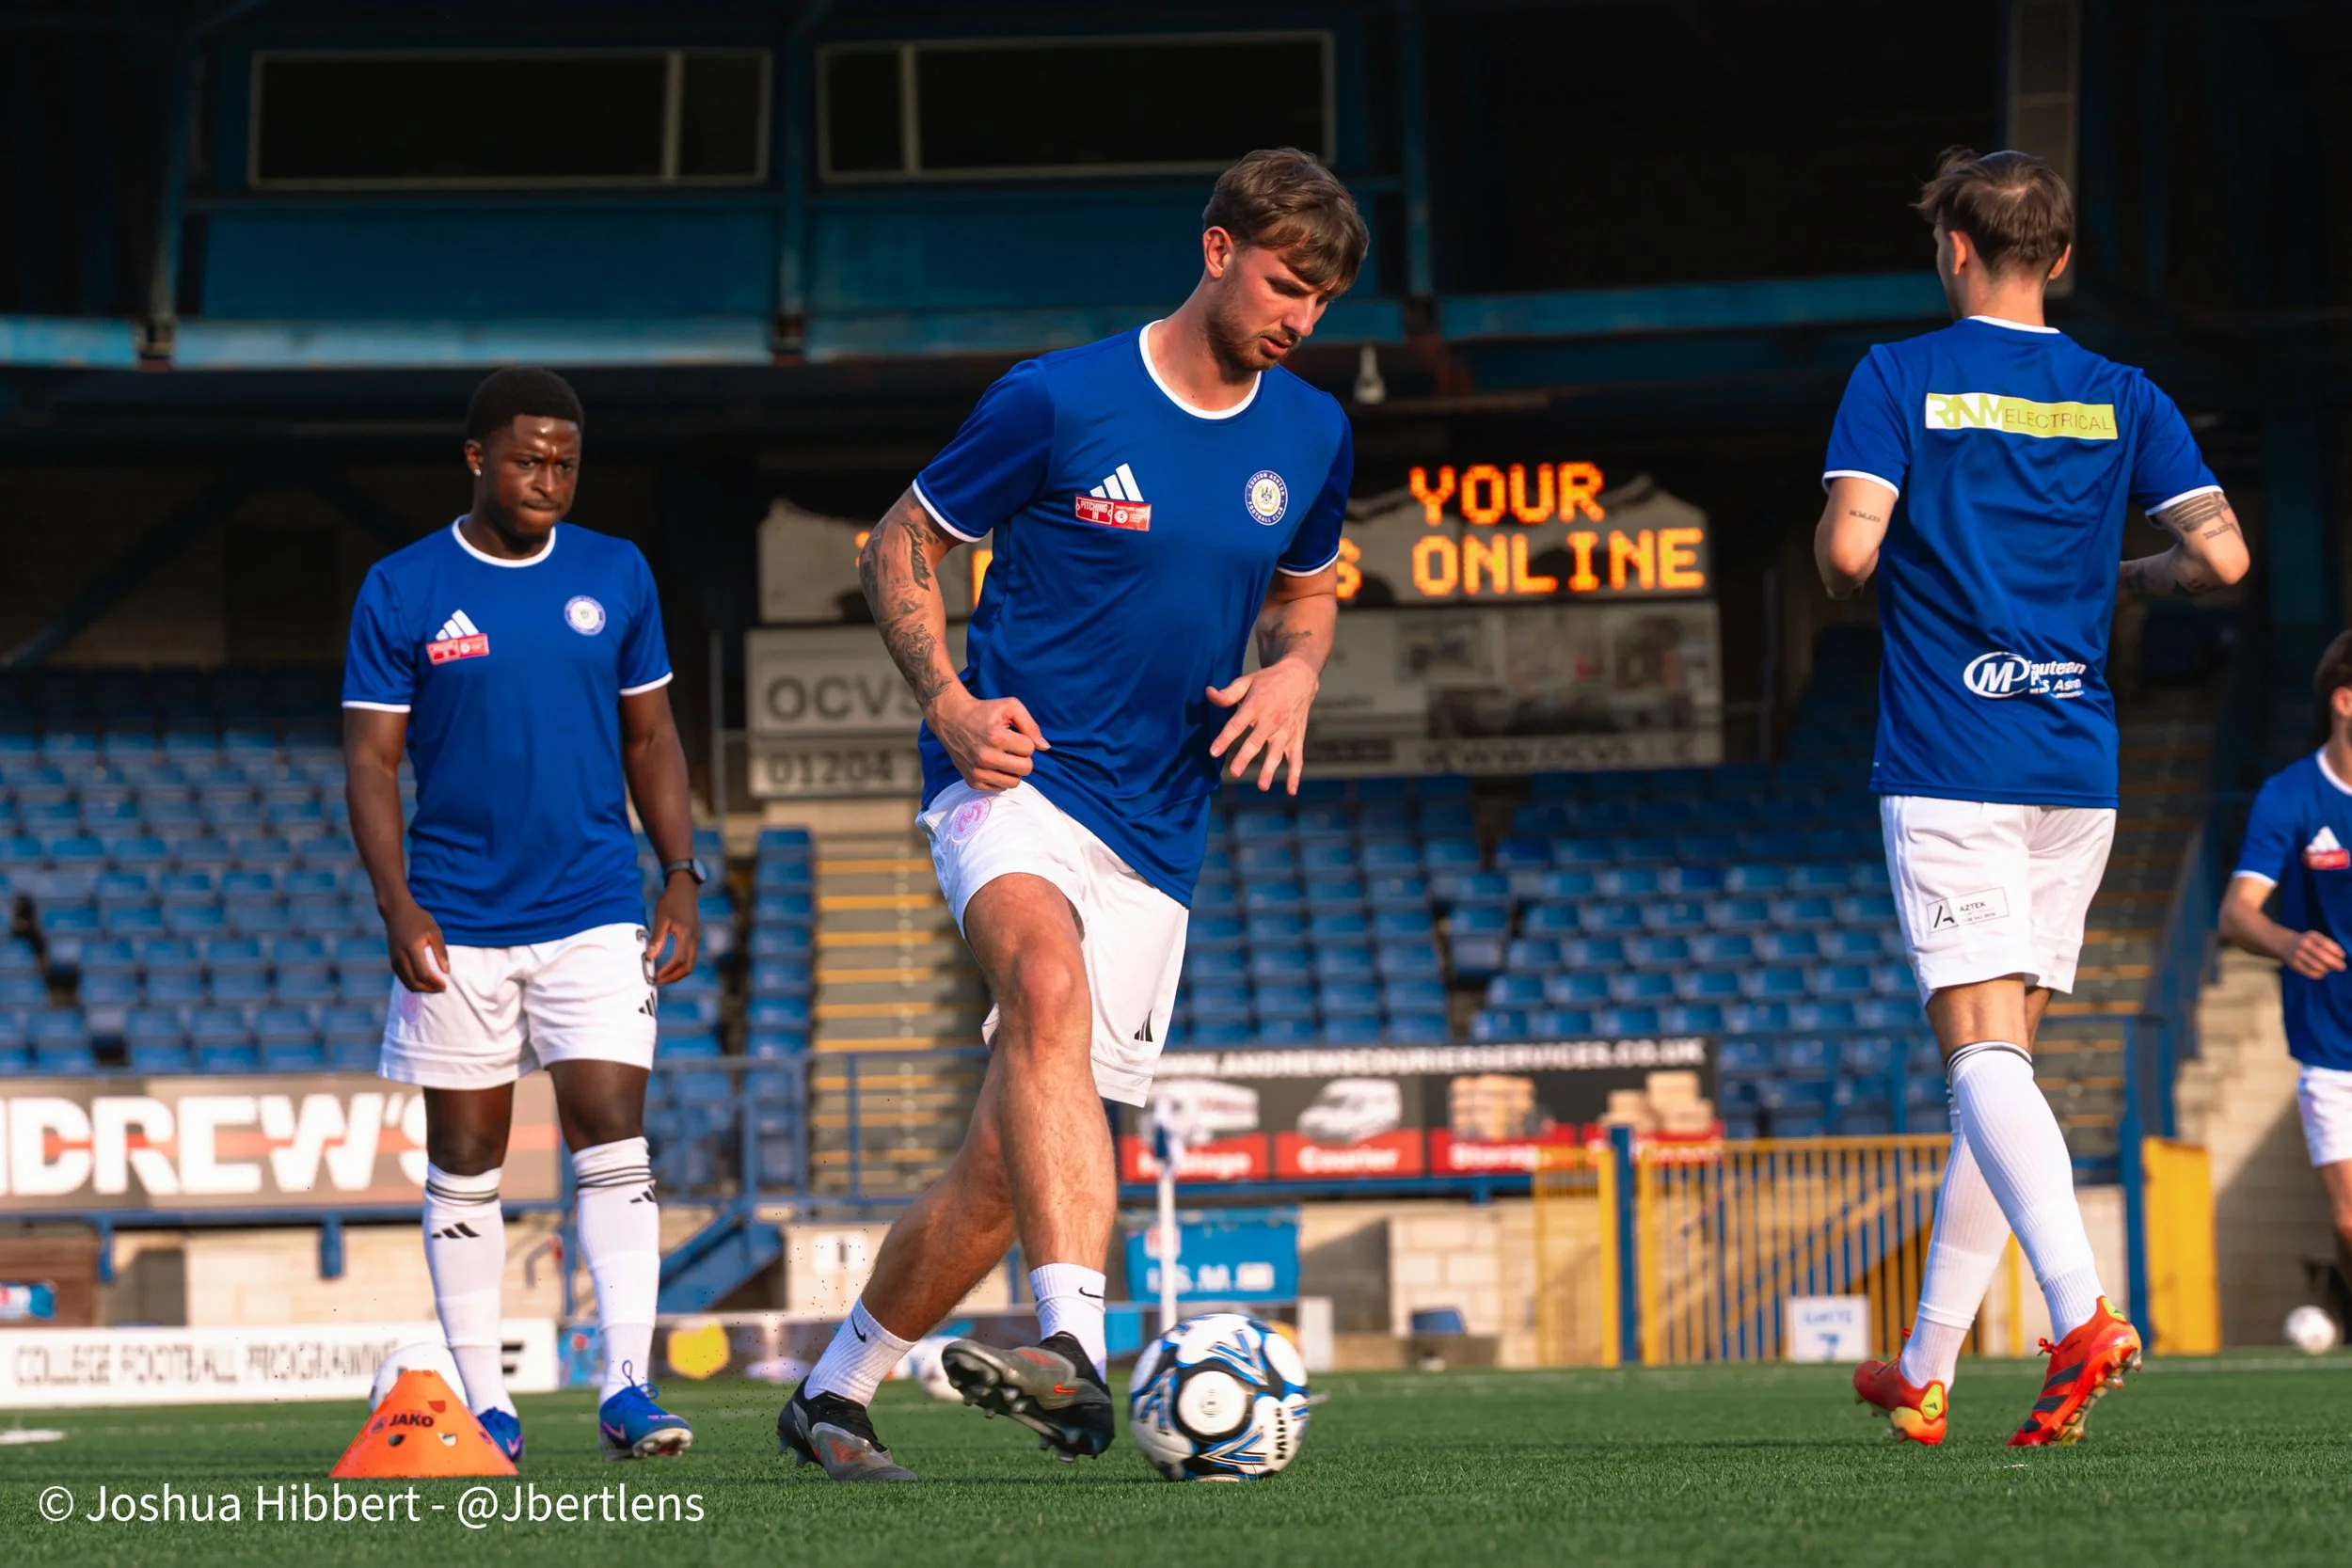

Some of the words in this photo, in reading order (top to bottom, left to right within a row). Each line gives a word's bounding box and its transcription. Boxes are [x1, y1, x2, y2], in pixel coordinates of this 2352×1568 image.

[2005, 408, 2114, 431] ELECTRICAL
[1409, 461, 1605, 527] YOUR
[1080, 500, 1108, 514] PITCHING
[1091, 512, 1100, 521] IN
[1412, 527, 1706, 597] ONLINE
[1960, 901, 1987, 912] AZTEK
[0, 1091, 427, 1196] DREW'
[13, 1343, 111, 1387] COLLEGE
[120, 1342, 238, 1385] FOOTBALL
[246, 1338, 399, 1381] PROGRAMM
[389, 1414, 434, 1427] JAKO
